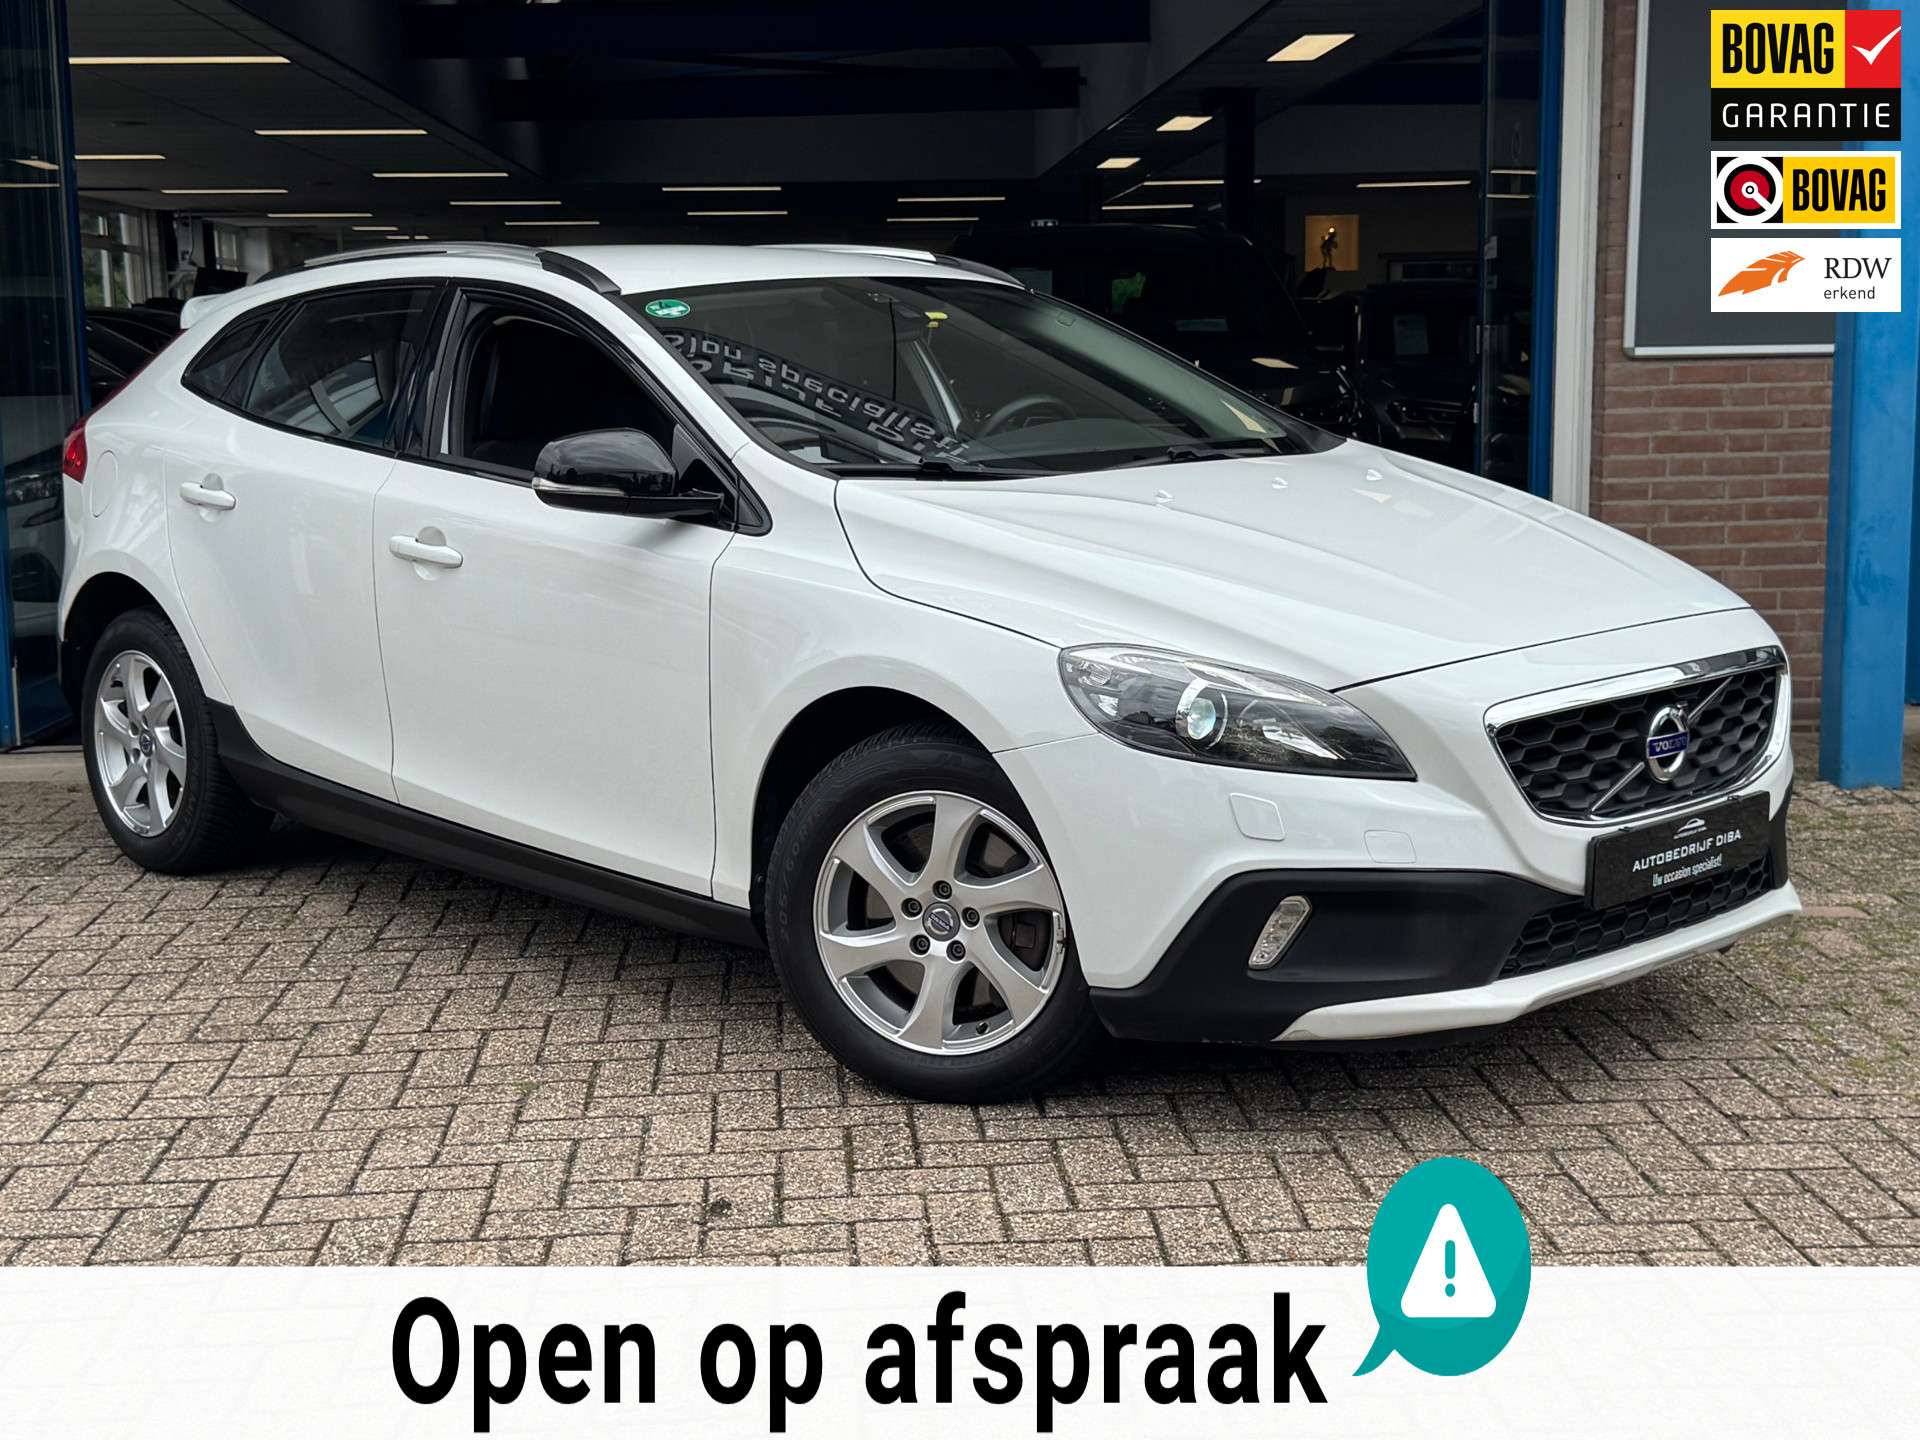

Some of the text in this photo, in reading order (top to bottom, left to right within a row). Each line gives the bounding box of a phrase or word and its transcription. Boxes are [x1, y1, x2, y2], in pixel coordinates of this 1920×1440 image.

[1632, 837, 1715, 872] AUTOBEDRIJF
[1715, 828, 1742, 848] DIBA
[1663, 864, 1692, 885] occasion
